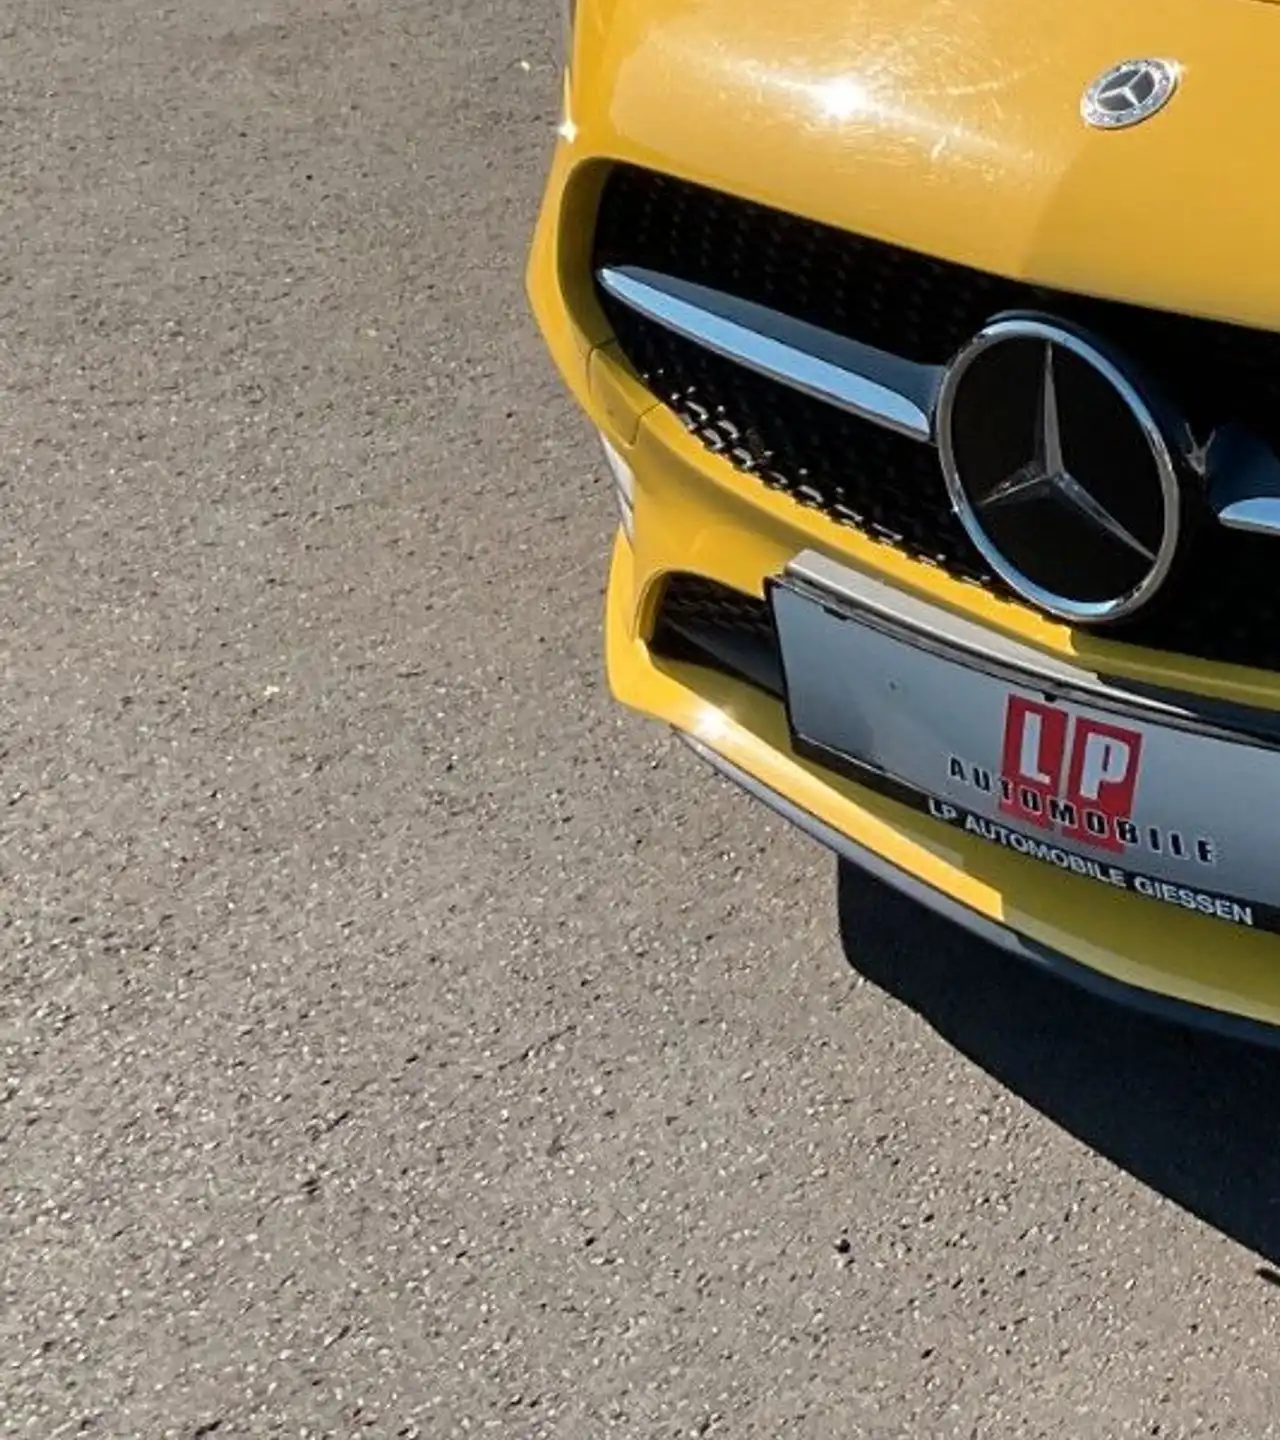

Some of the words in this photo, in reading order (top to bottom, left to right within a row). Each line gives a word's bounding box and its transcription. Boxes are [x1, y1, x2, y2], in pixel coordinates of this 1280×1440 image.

[949, 755, 1216, 865] AUTOMOBILE
[1019, 710, 1131, 800] LP
[927, 798, 958, 823] LP
[963, 813, 1127, 888] AUTOMOBILE
[1133, 875, 1253, 927] GIESSEN
